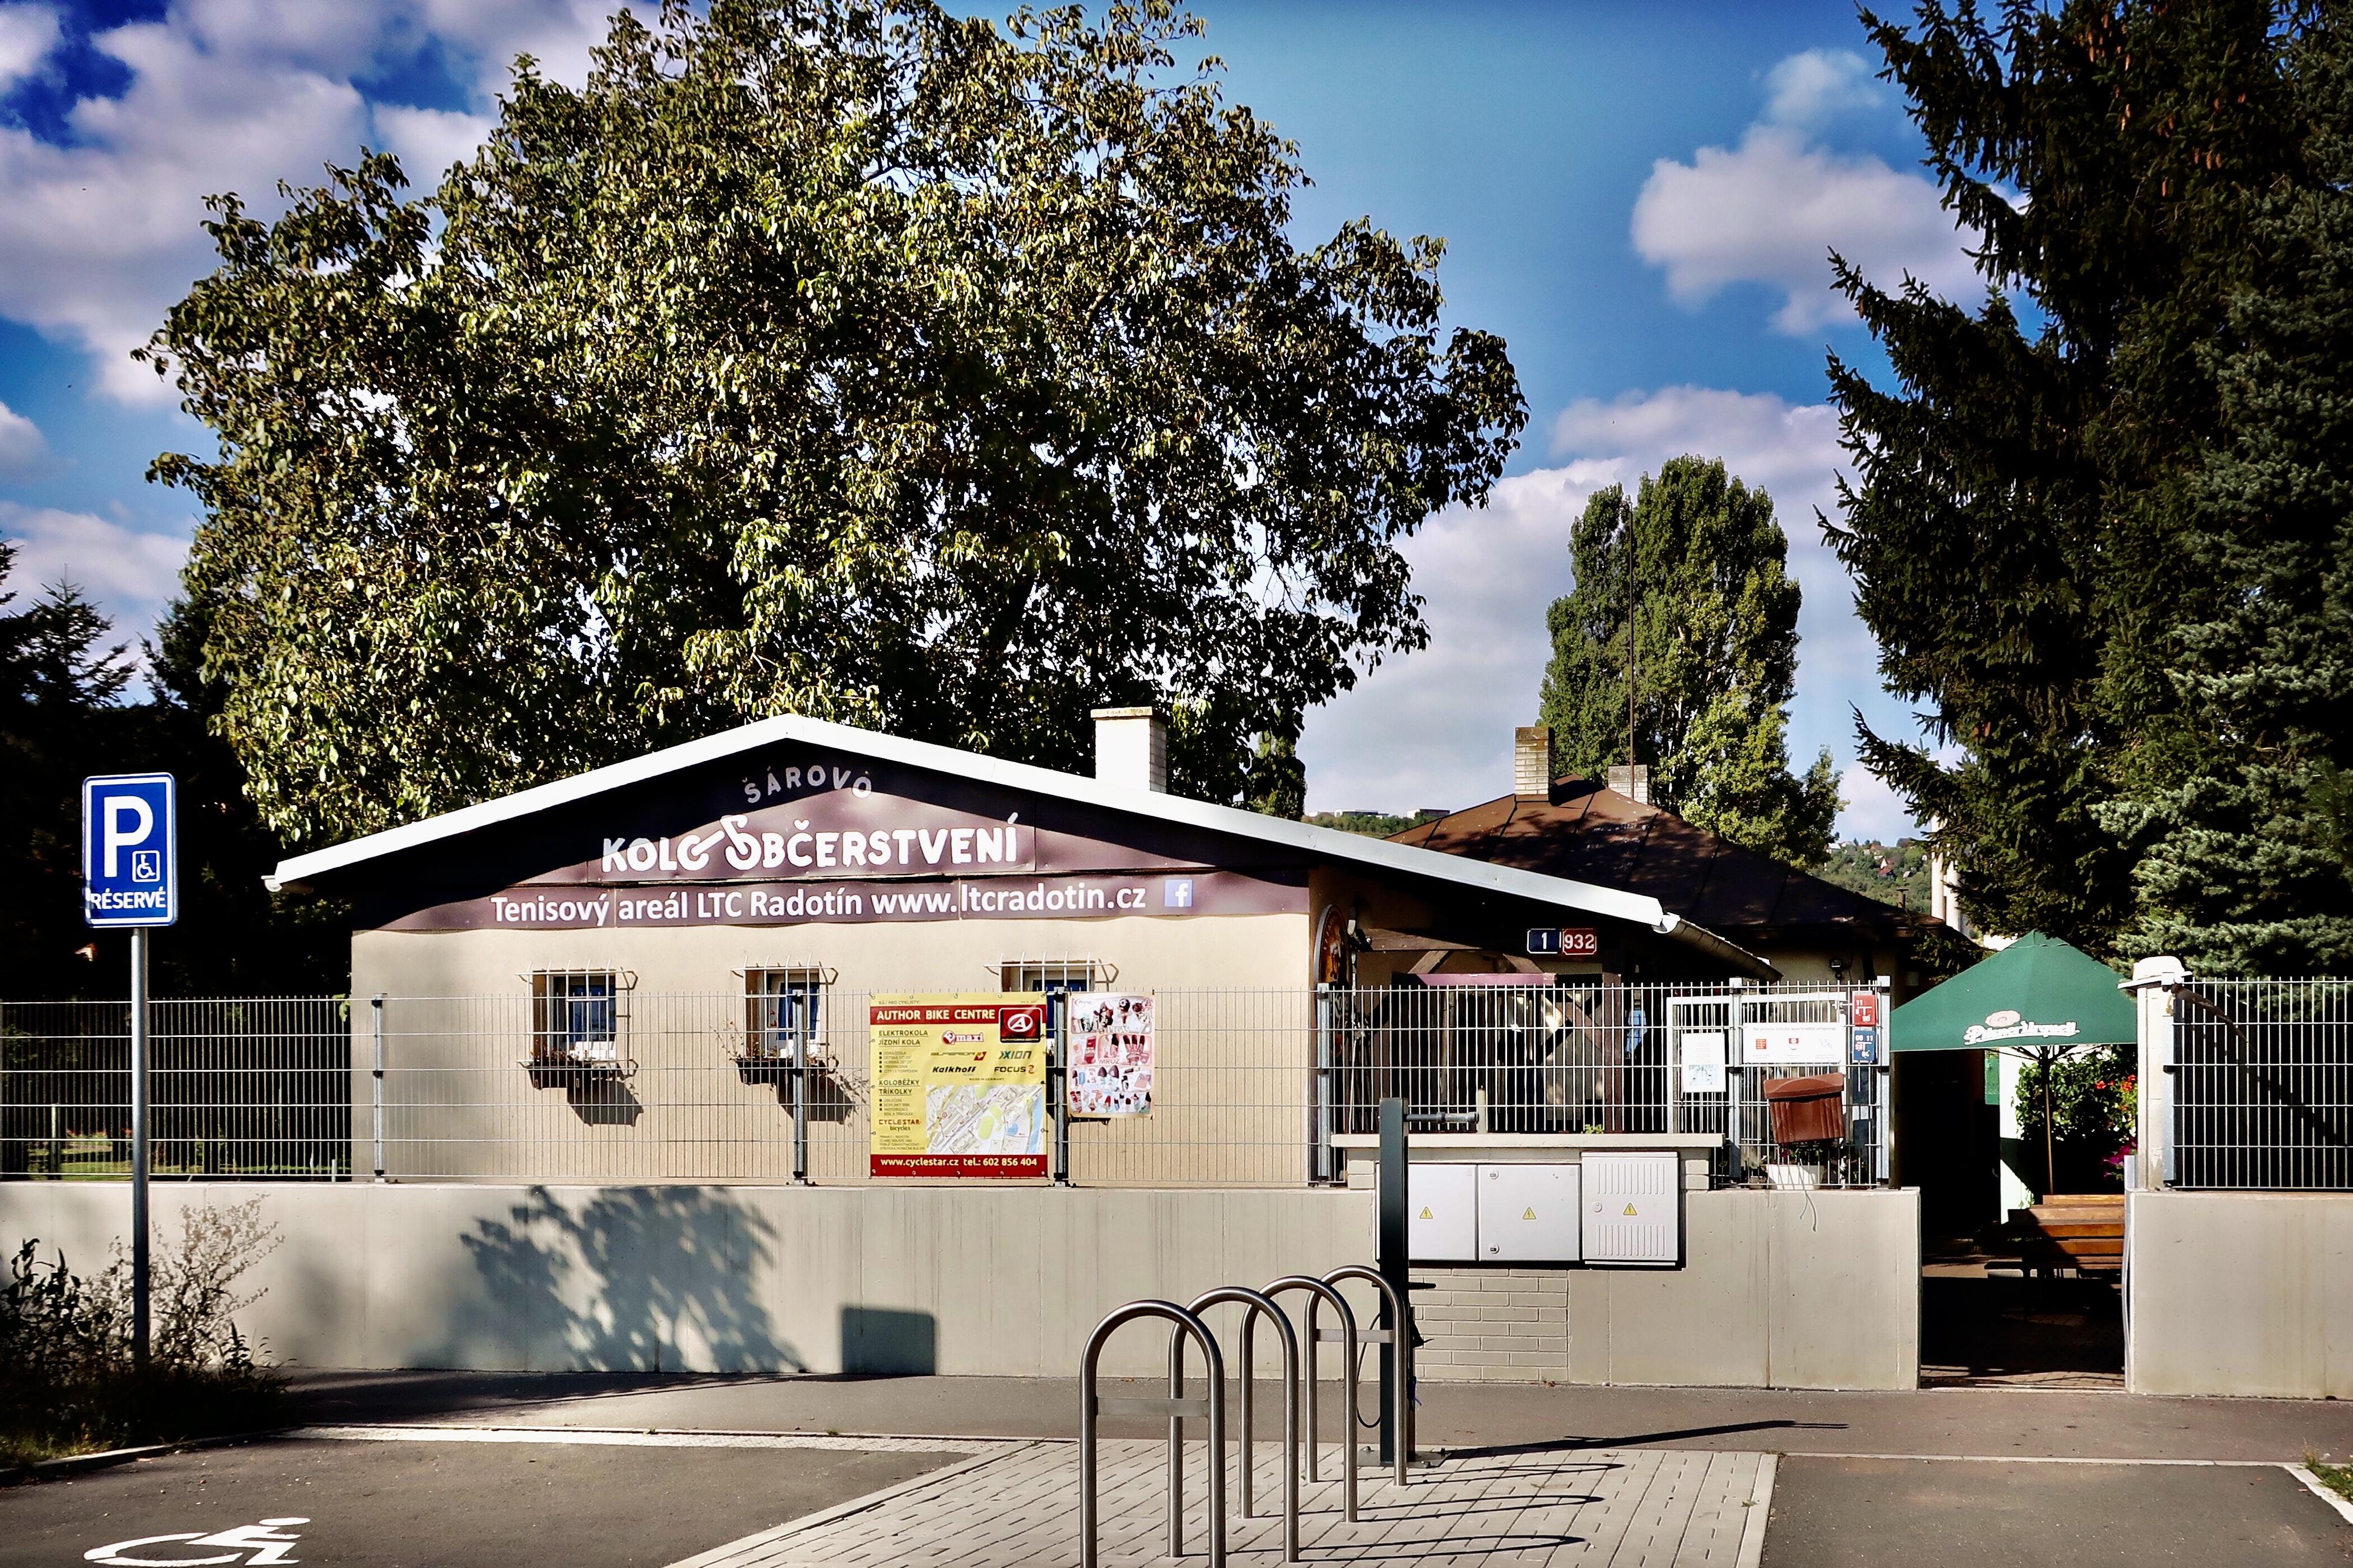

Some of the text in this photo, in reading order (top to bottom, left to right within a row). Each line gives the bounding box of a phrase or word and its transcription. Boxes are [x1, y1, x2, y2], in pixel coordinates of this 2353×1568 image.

[104, 795, 154, 878] P
[91, 886, 166, 909] RÉSERVÉ
[490, 882, 1146, 927] Tenisový areál LTC Radotín www.ltcradotin.cz
[1541, 932, 1547, 949] 1
[1564, 934, 1595, 949] 932
[876, 1009, 995, 1020] AUTHOR BIKE CENTRE
[1963, 1025, 2022, 1045] Pilsner
[881, 1157, 959, 1167] www.cyclestar.cz
[963, 1157, 981, 1166] tel.:
[1002, 1158, 1018, 1166] 856
